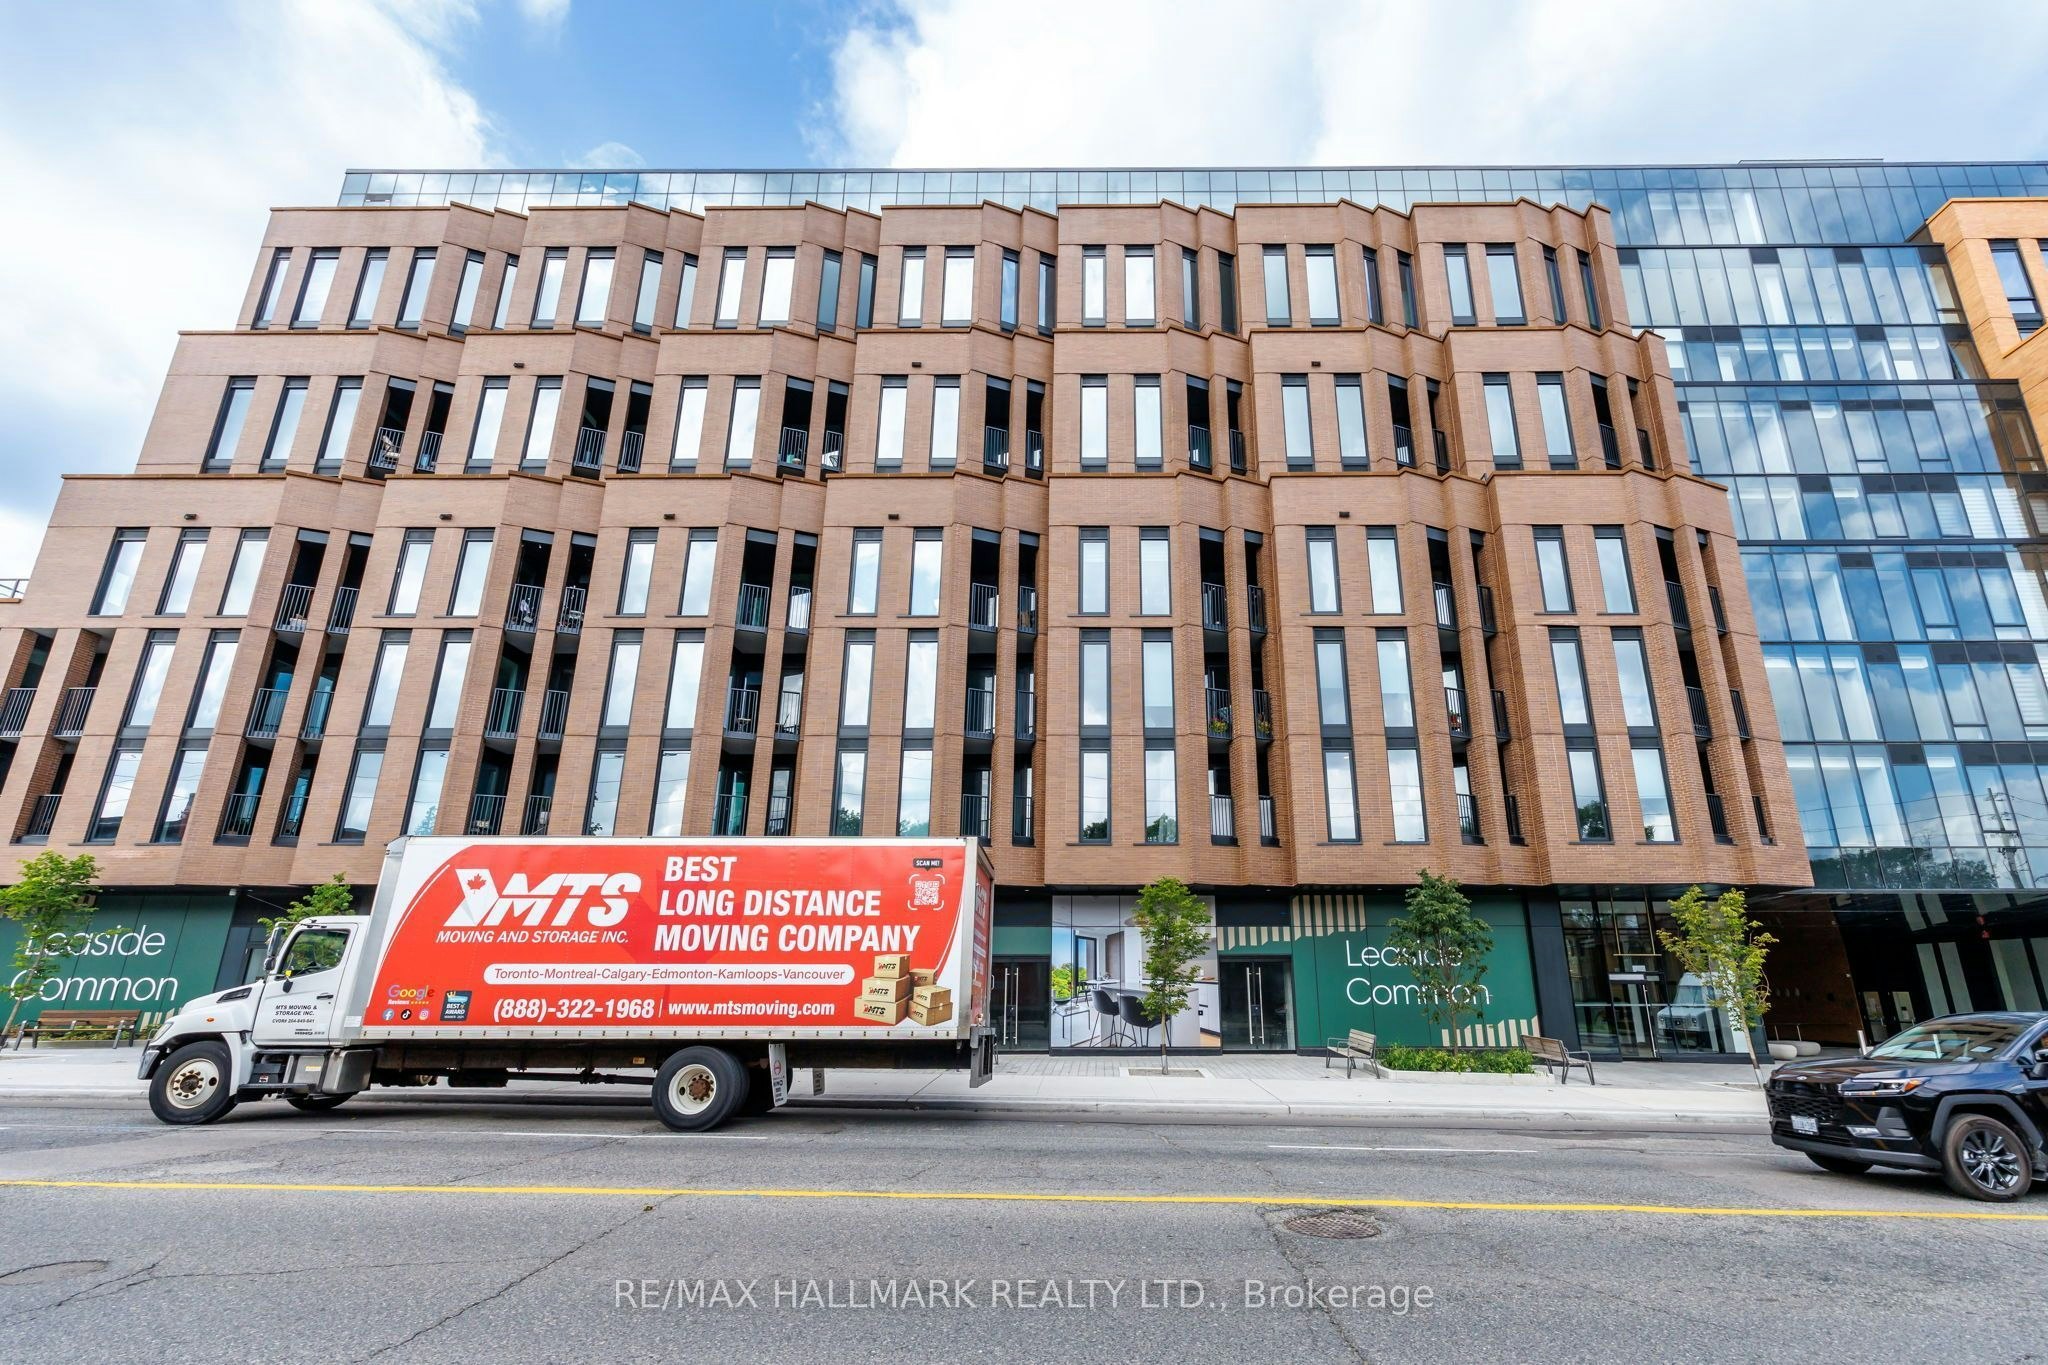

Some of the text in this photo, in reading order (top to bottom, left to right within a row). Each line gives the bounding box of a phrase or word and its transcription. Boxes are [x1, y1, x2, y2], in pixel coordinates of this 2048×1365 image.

[664, 855, 738, 882] BEST
[482, 872, 642, 927] MTS
[659, 889, 882, 917] LONG DISTANCE
[436, 930, 630, 944] MOVING AND STORAGE INC.
[653, 924, 921, 952] MOVING COMPANY
[9, 968, 179, 1001] Common
[494, 967, 846, 982] Toronto-Montreal-Calgary-Edmonton-Kamloops-Vancouver
[387, 984, 435, 1000] Google
[493, 998, 835, 1023] (888)-322-1968 www.mtsmoving.com
[867, 1005, 886, 1015] MTS
